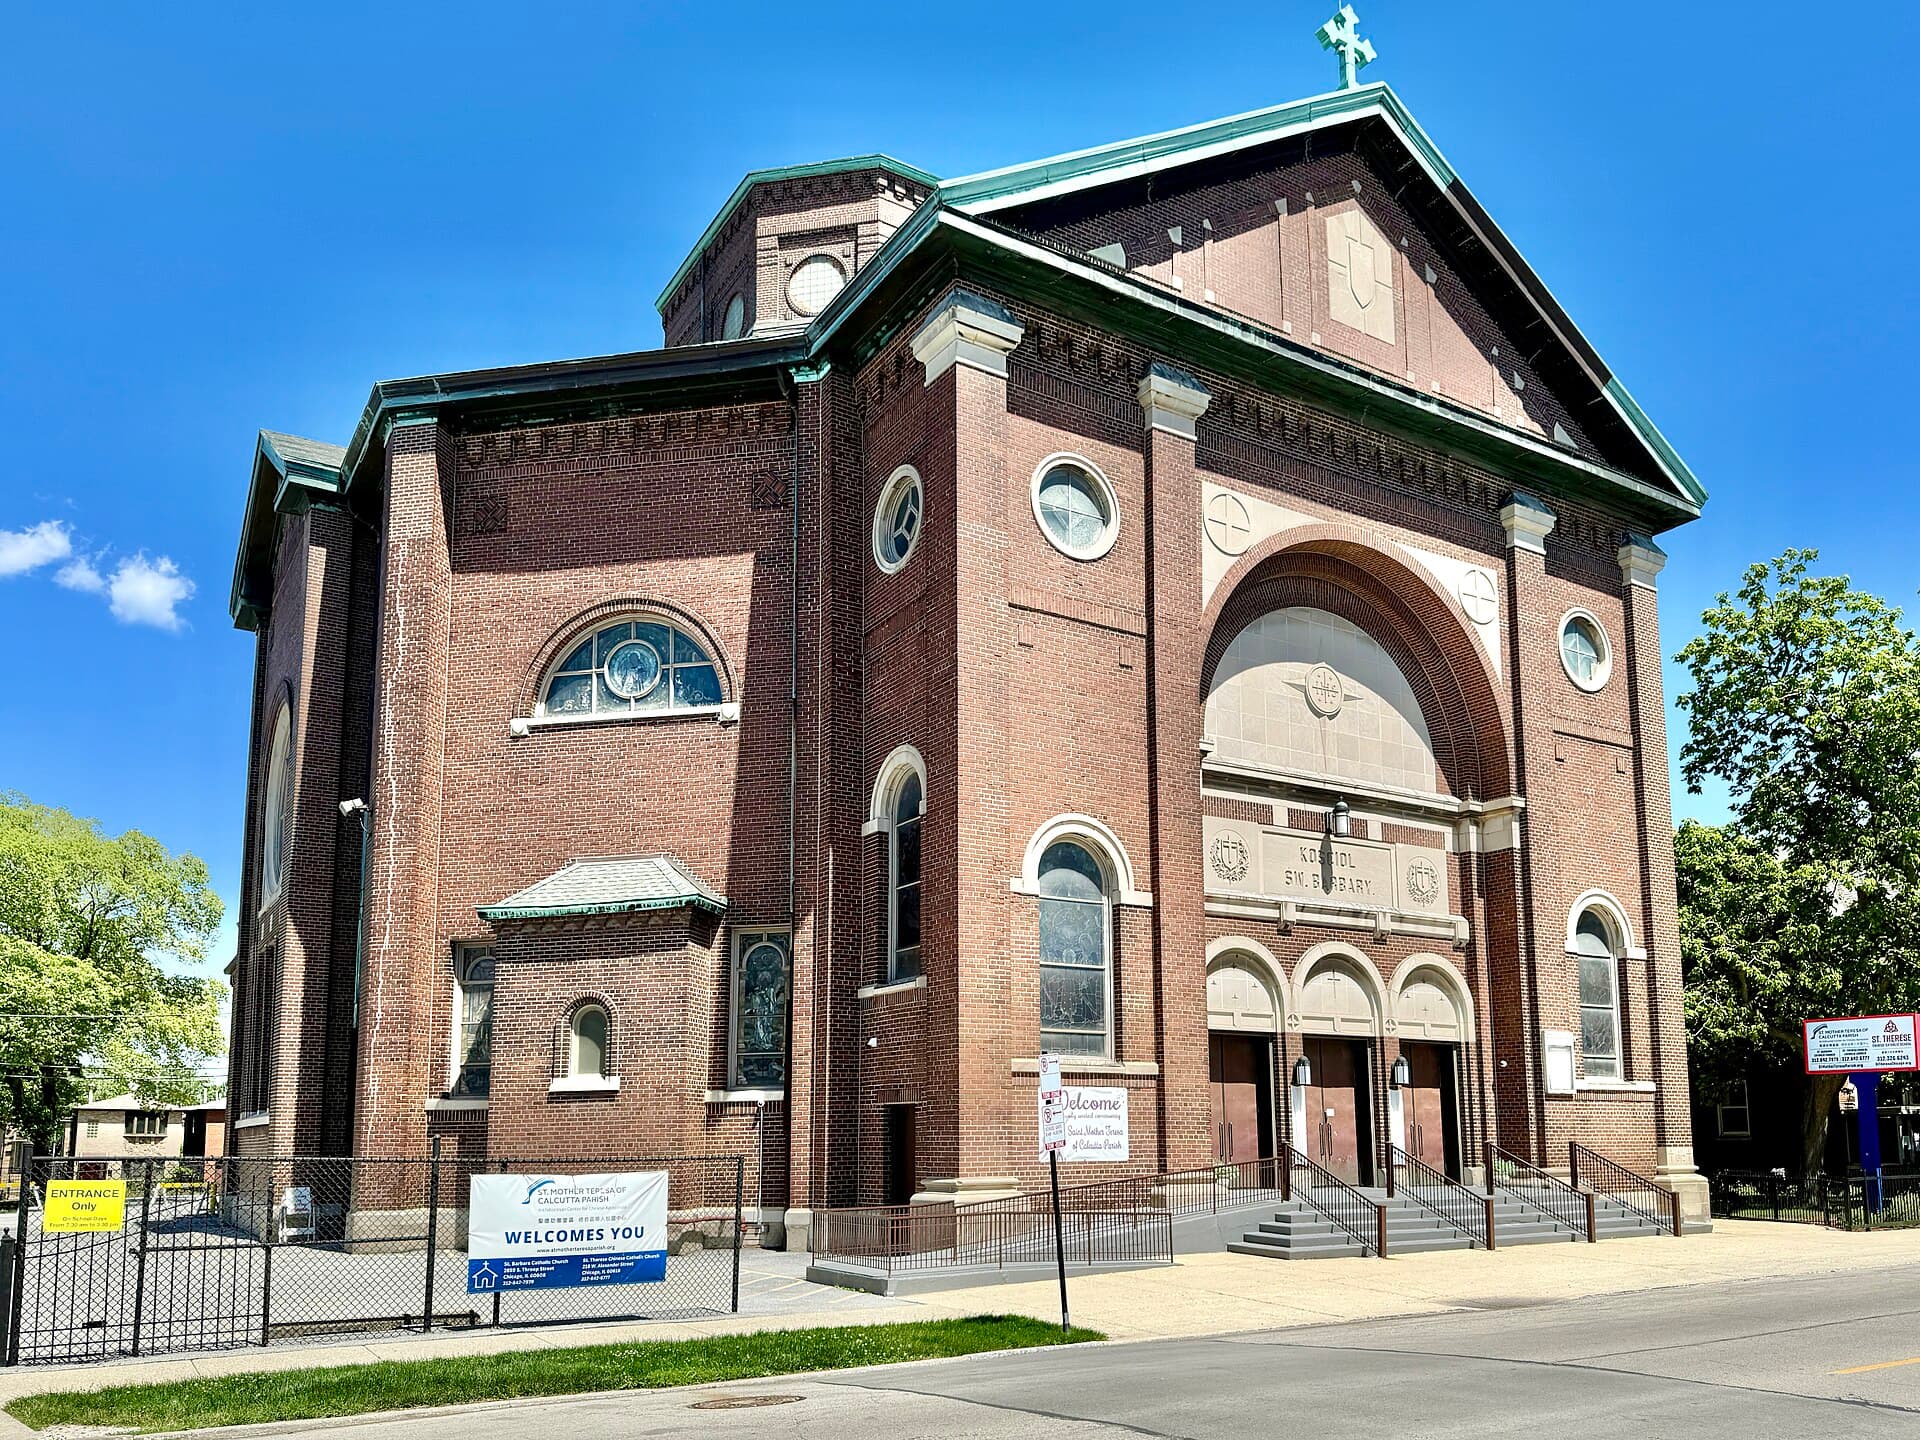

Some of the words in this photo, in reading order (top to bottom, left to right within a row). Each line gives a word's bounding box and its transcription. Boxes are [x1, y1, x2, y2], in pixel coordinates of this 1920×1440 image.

[1311, 873, 1376, 896] BRBARY.
[1872, 1035, 1882, 1043] ST.
[1883, 1034, 1912, 1043] THERESE
[51, 1189, 120, 1198] ENTRANCE
[72, 1202, 96, 1212] Only
[505, 1228, 604, 1244] WELCOMES
[611, 1226, 645, 1240] YOU
